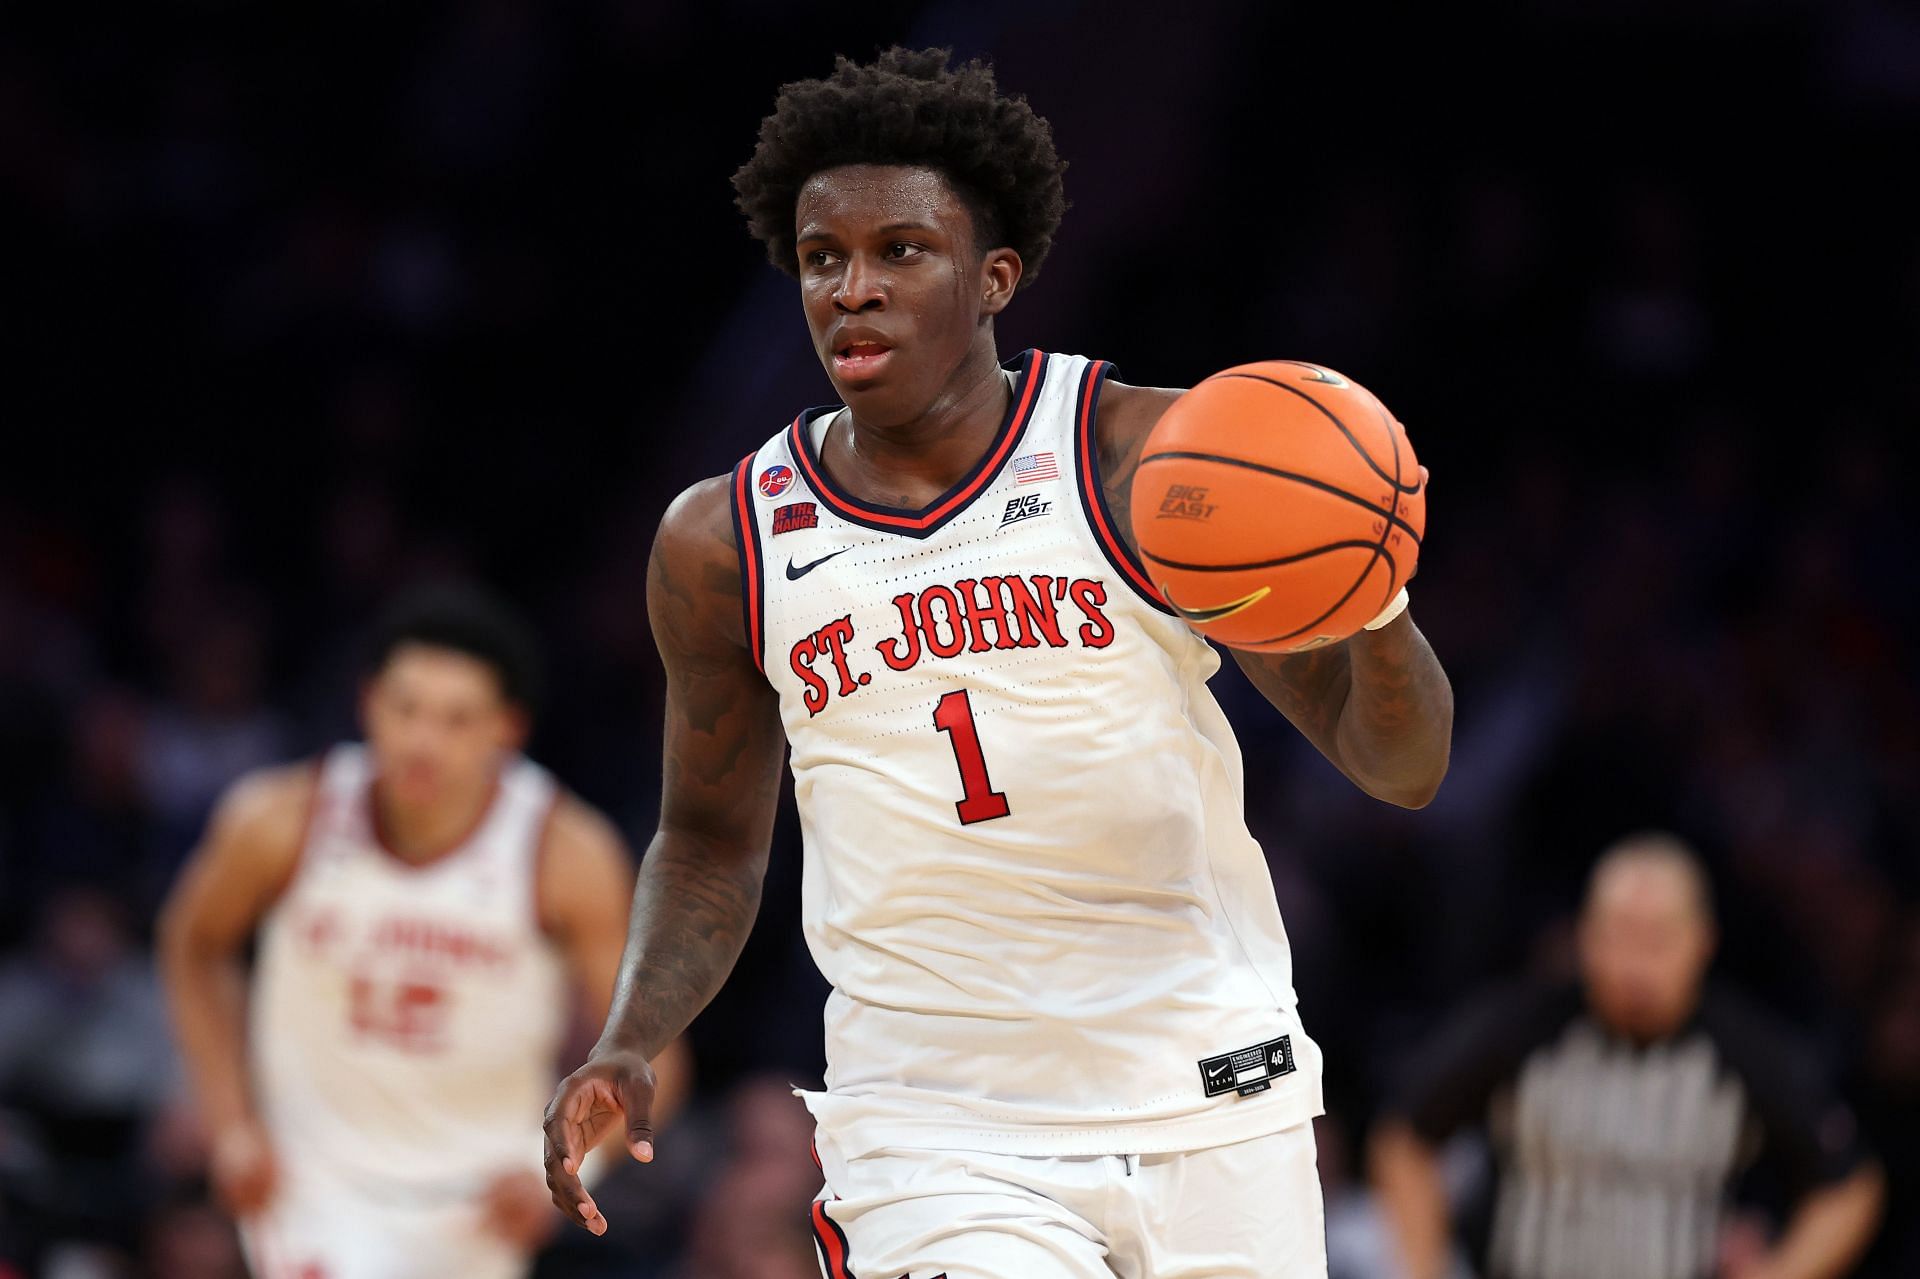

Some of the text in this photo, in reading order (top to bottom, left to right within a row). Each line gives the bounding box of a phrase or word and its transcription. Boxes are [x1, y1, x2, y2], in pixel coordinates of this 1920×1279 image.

[761, 470, 792, 492] Lou
[1166, 484, 1210, 500] BIG
[791, 503, 814, 517] THE
[1005, 493, 1041, 512] BIG
[1160, 498, 1217, 518] EAST
[1001, 502, 1052, 523] EAST
[774, 515, 817, 534] HANGE
[789, 574, 1115, 718] ST. JOHN'S
[932, 688, 1011, 826] 1
[1271, 1050, 1284, 1066] 46
[1210, 1076, 1233, 1087] TEAM
